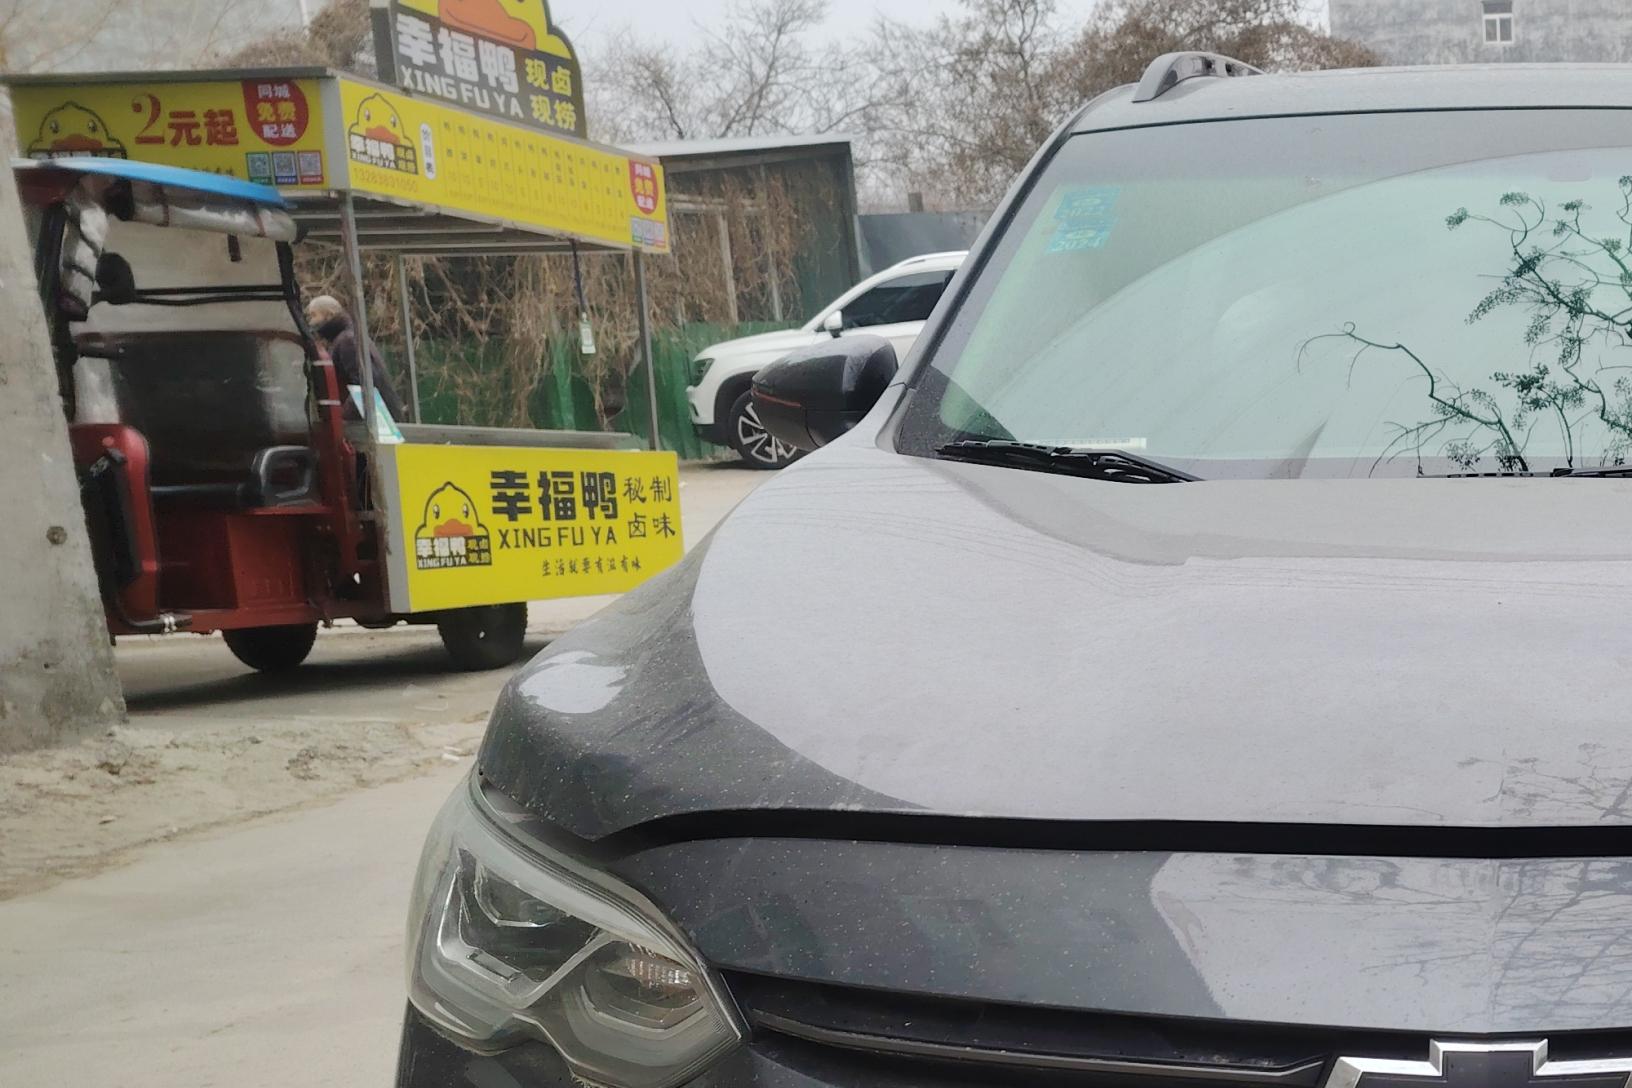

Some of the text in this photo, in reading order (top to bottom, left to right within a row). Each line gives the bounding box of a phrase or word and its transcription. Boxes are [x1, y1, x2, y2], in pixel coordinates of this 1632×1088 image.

[396, 13, 520, 94] 幸福鸭
[257, 84, 290, 99] 同城
[401, 65, 525, 118] XING FU YA
[525, 58, 572, 96] 现卤
[132, 92, 240, 147] 2元起
[256, 101, 297, 122] 免费
[530, 95, 577, 130] 现捞
[262, 122, 297, 139] 配送
[490, 470, 618, 521] 幸福鸭
[623, 475, 672, 504] 秘制
[498, 525, 618, 549] XING FU YA
[627, 511, 676, 539] 卤味
